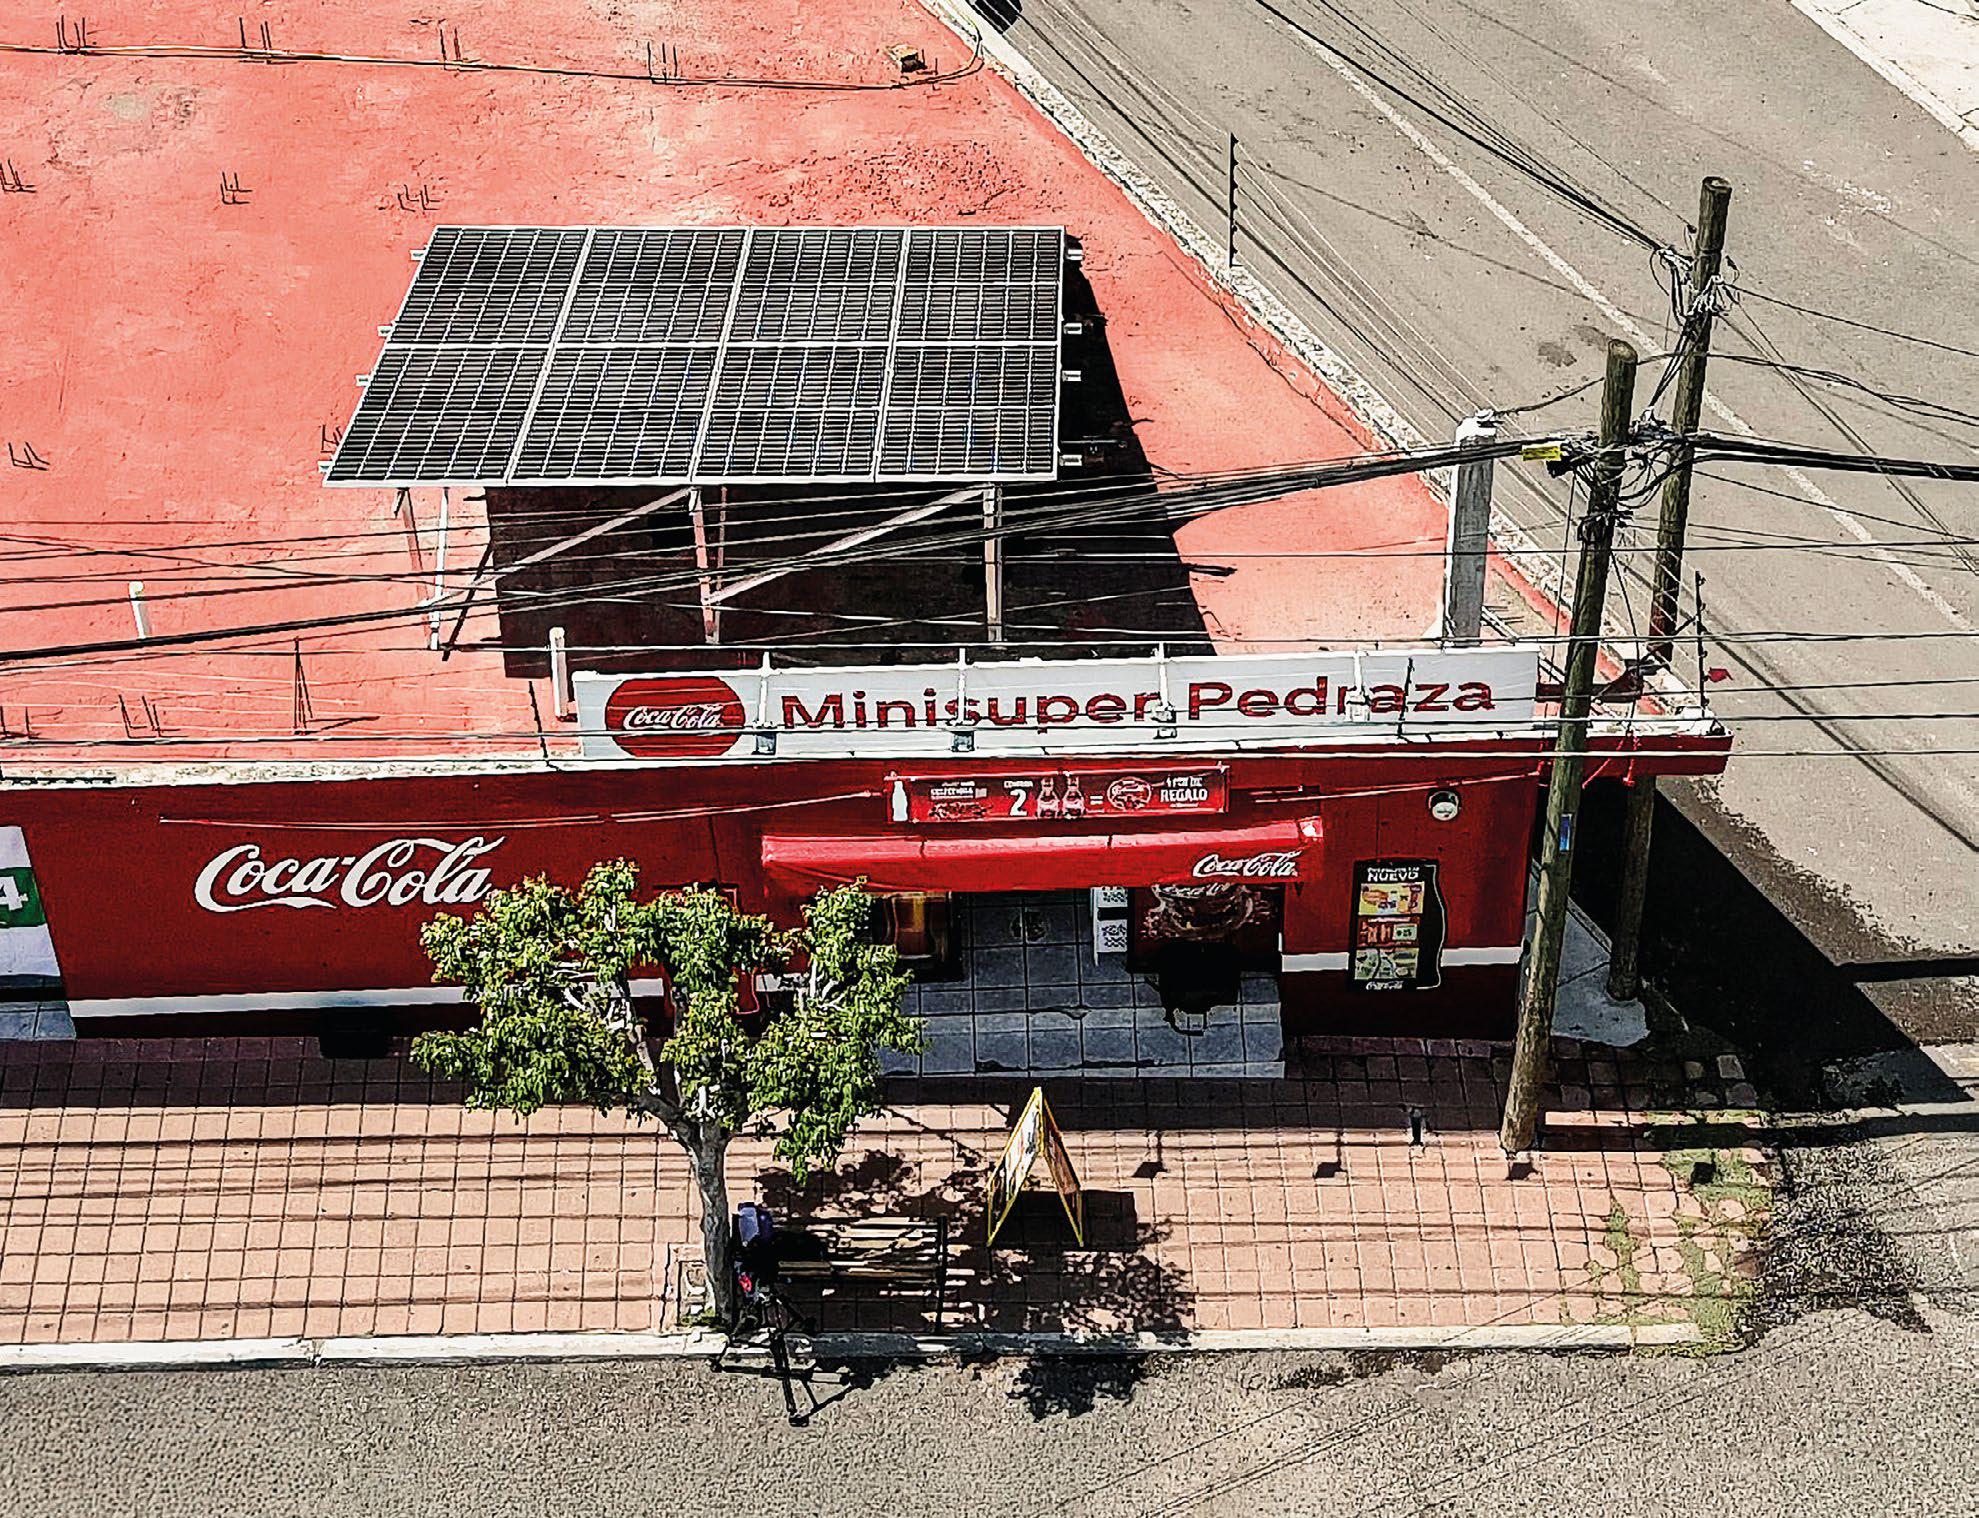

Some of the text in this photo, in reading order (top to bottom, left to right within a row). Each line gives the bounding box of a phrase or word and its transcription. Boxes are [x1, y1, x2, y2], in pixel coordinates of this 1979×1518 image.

[780, 676, 1496, 735] Minisuper Pedraza
[1009, 788, 1029, 817] 2
[1160, 787, 1208, 803] REGALO
[194, 835, 506, 914] Coca-Cola
[1192, 850, 1303, 878] Coca-Cola
